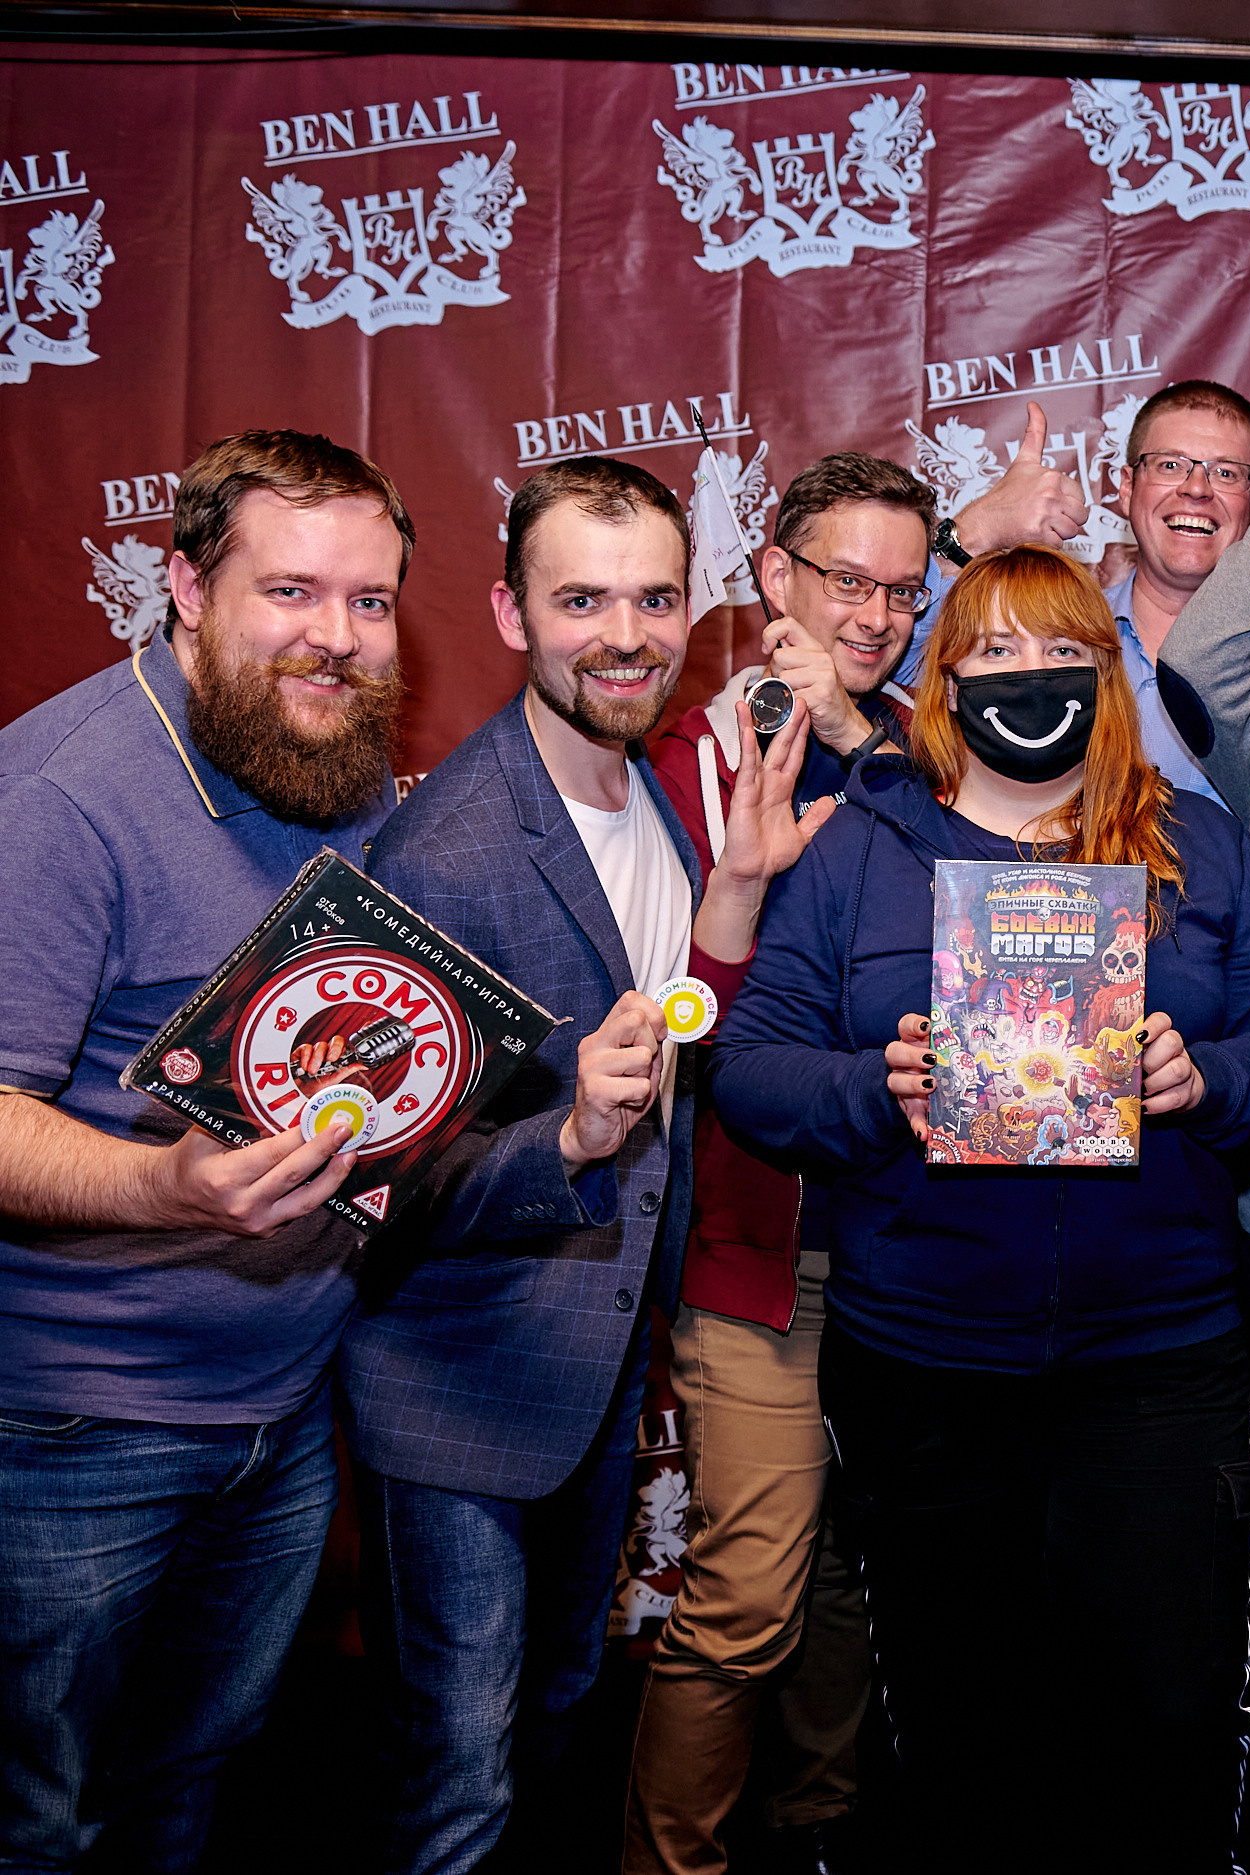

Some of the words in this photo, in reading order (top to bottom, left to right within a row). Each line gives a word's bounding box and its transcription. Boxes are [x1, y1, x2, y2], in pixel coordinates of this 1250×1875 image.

[671, 63, 766, 101] BEN
[260, 110, 356, 160] BEN
[364, 91, 498, 144] HALL
[0, 151, 87, 198] ALL
[1187, 187, 1248, 205] RESTAURANT
[779, 245, 841, 262] RESTAURANT
[924, 353, 1017, 401] BEN
[1028, 334, 1158, 386] HALL
[513, 410, 607, 460] BEN
[618, 392, 750, 445] HALL
[990, 899, 1044, 910] ЭПИЧНЫЕ
[1048, 899, 1098, 912] СХВАТКИ
[290, 920, 331, 941] 14+
[991, 911, 1096, 934] БОЕВЫХ
[991, 933, 1096, 957] МАГОВ
[655, 981, 705, 1005] СПОМНИТЬ
[316, 968, 448, 1069] COMIC
[310, 1090, 373, 1113] ВСПОМНИТЬ
[158, 1084, 224, 1132] РАЗВИВАЙ
[226, 1129, 251, 1149] СВО
